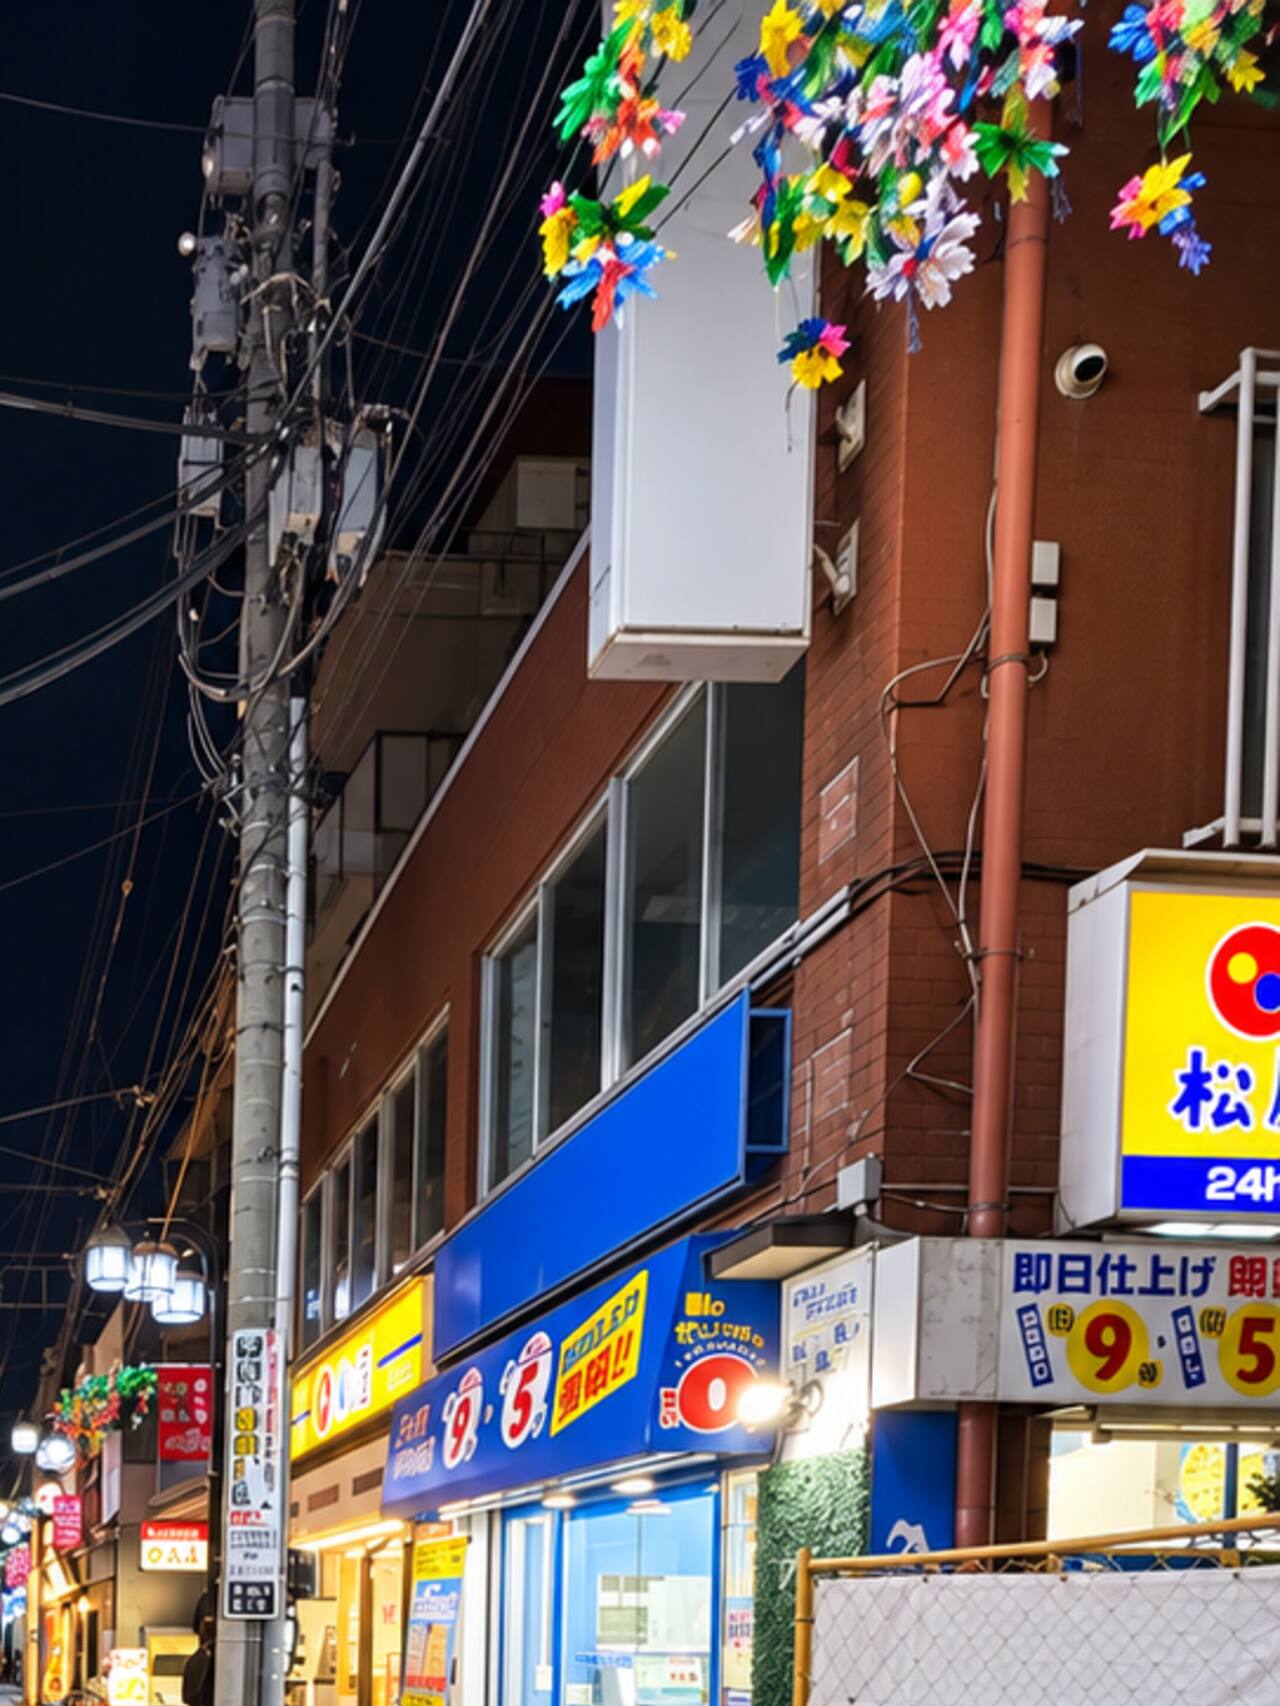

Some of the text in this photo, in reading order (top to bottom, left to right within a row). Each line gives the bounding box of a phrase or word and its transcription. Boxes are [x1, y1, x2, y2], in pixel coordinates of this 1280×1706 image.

[1170, 1049, 1280, 1128] 松
[1012, 1252, 1217, 1297] 即日仕上げ
[1084, 1313, 1132, 1381] 9
[1235, 1317, 1276, 1384] 5
